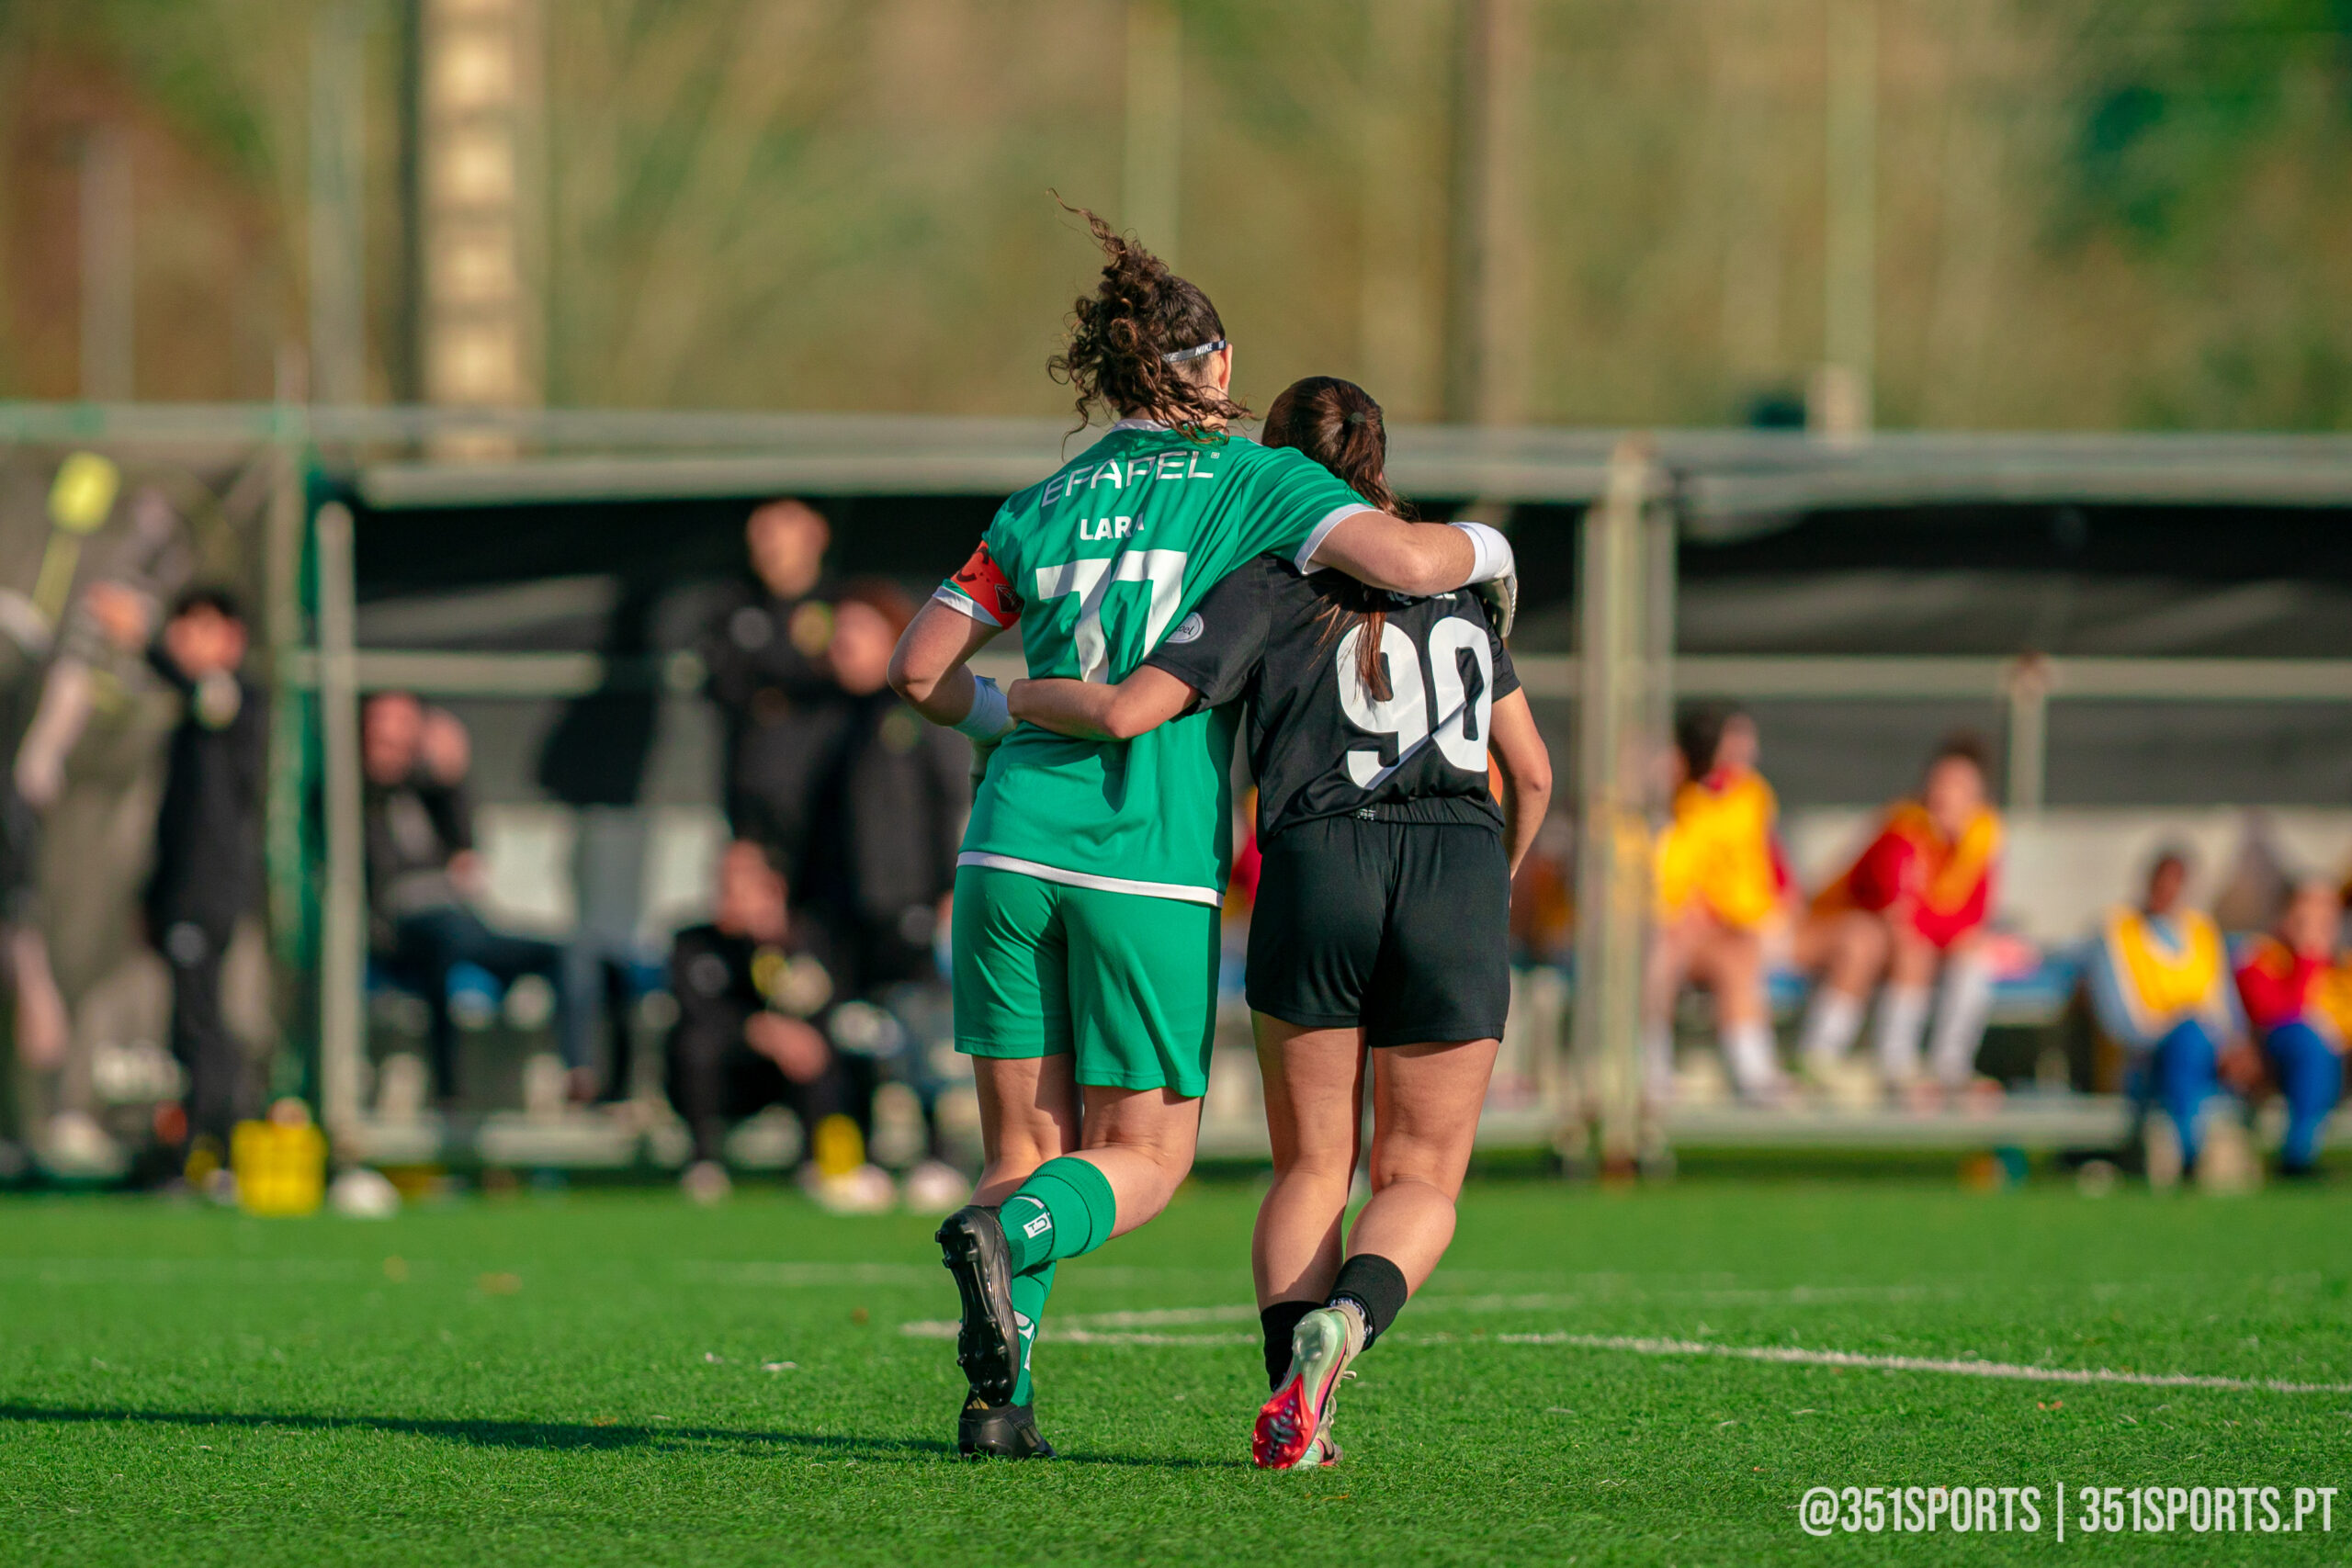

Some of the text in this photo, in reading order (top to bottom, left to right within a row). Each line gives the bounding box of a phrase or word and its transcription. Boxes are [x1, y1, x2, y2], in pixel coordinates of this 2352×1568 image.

[1194, 342, 1213, 356] NIKE
[1042, 451, 1214, 507] EFAPEL
[1035, 548, 1188, 683] 77
[1336, 616, 1494, 790] 90
